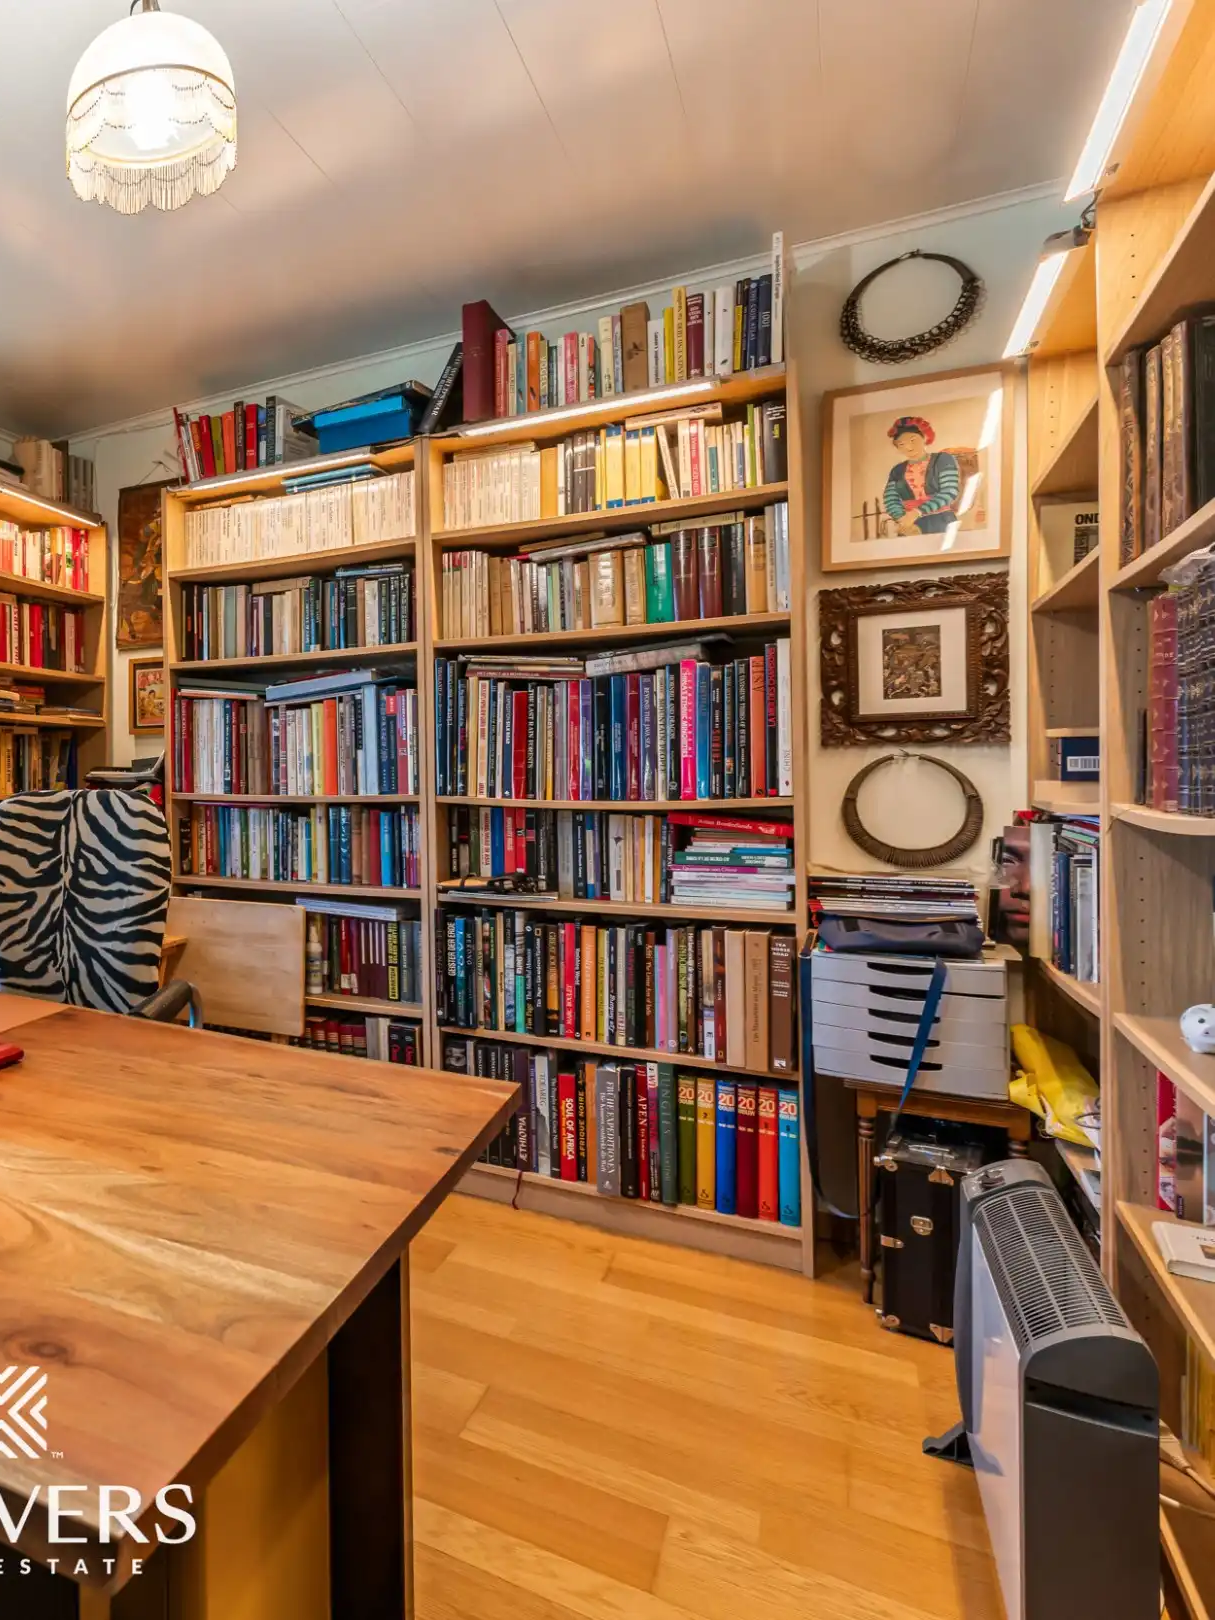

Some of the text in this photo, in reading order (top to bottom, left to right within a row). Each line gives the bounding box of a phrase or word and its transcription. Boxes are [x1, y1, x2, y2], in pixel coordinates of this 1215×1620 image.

[431, 399, 444, 416] WAR
[447, 939, 456, 952] DER
[447, 953, 456, 976] GEISTER
[679, 1087, 694, 1099] 20
[698, 1091, 714, 1102] 20
[718, 1093, 735, 1106] 20
[738, 1097, 755, 1110] 20
[759, 1099, 775, 1112] 20
[779, 1102, 797, 1115] 20
[638, 1094, 647, 1127] APEN
[566, 1097, 575, 1160] SOUL OF AFRICA
